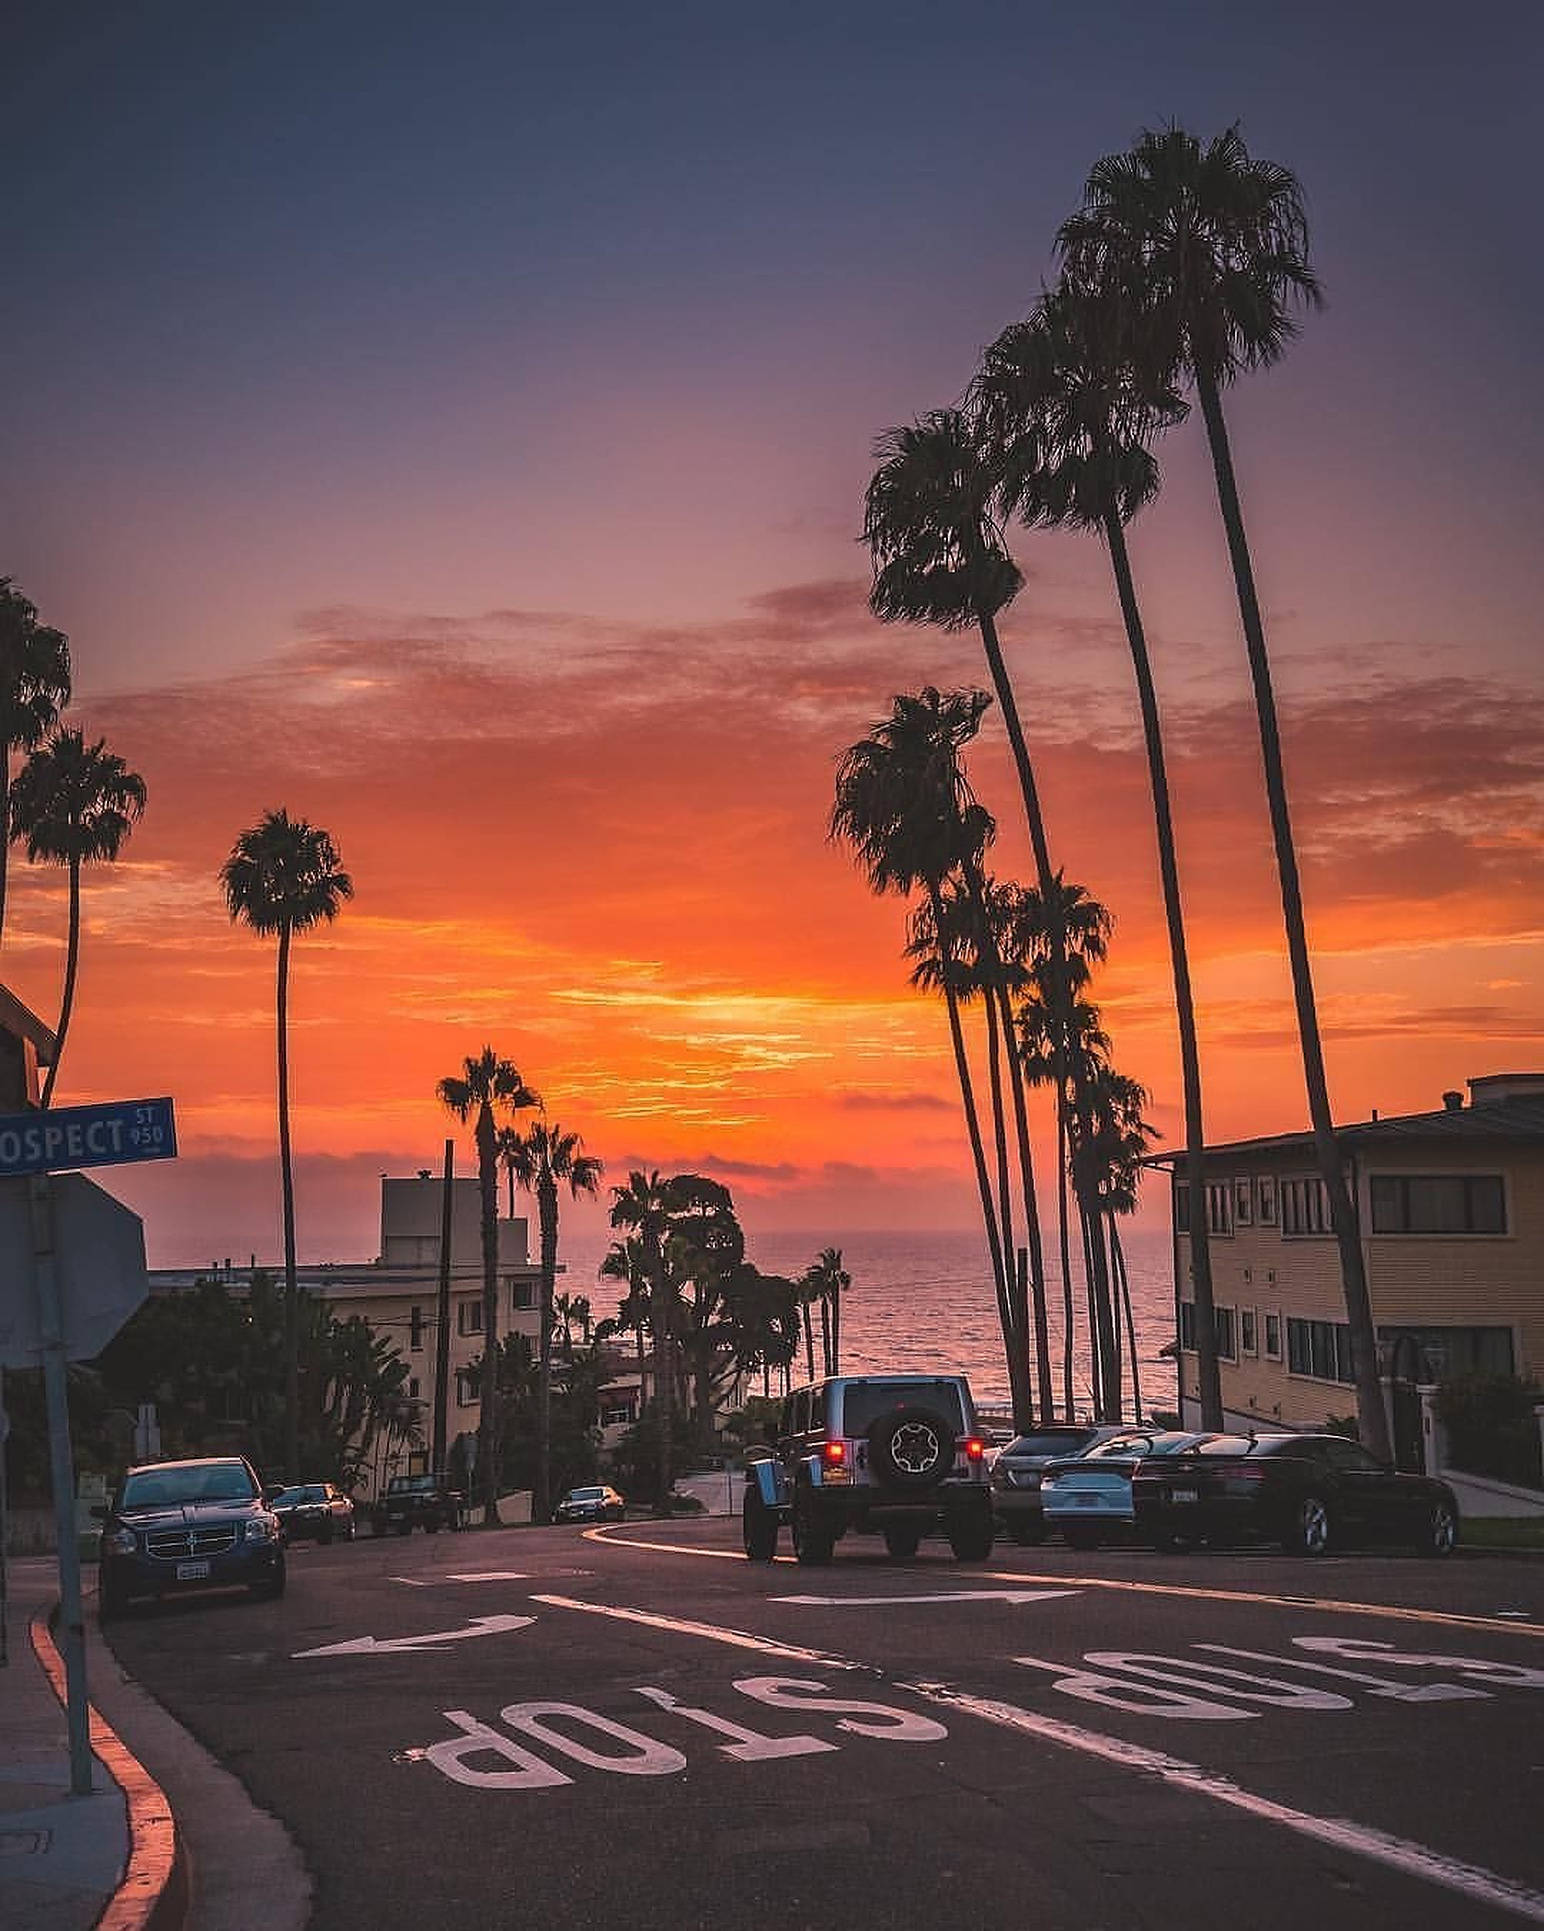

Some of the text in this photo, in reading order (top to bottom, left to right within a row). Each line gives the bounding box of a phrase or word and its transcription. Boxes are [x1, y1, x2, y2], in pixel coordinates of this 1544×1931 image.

[136, 1107, 154, 1124] ST
[1012, 1636, 1544, 1720] STOP
[426, 1676, 949, 1789] STOP
